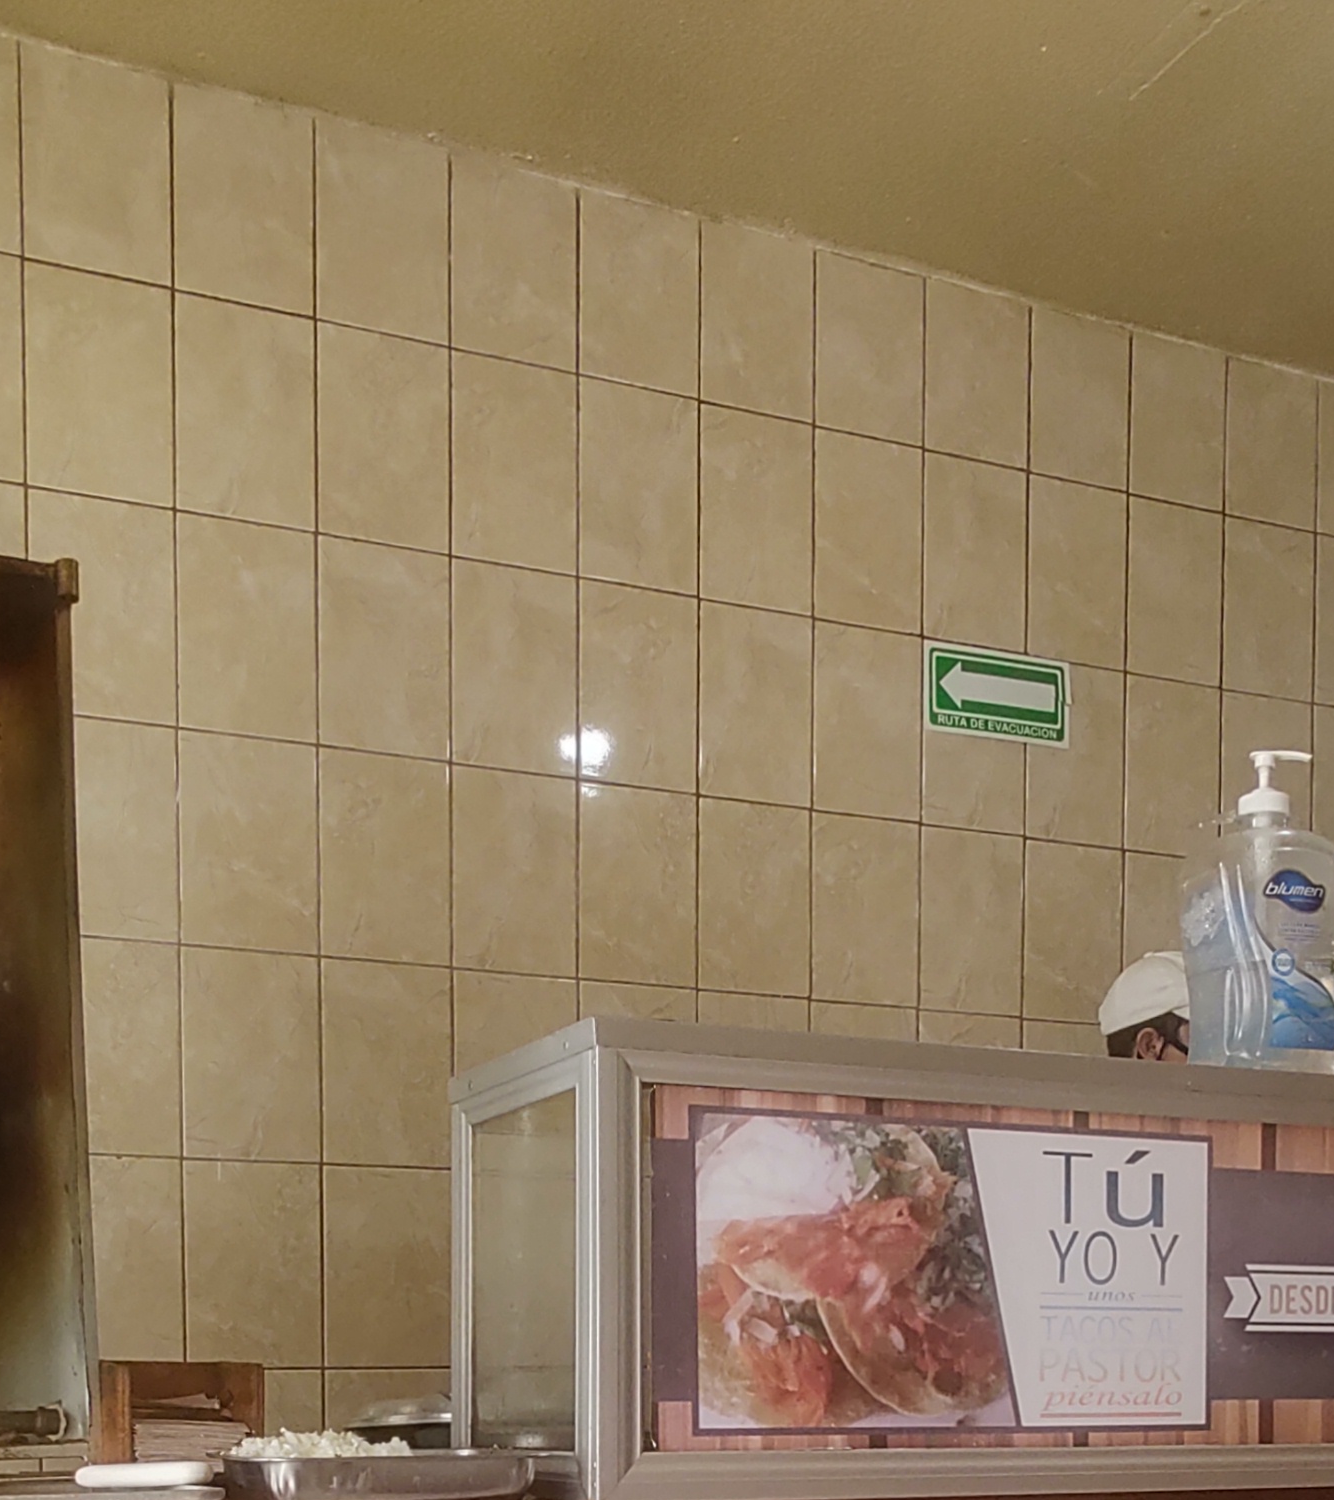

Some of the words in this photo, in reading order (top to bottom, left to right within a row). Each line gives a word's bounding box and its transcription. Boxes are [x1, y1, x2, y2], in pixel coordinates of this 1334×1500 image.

[937, 714, 967, 727] RUTA
[970, 718, 985, 729] DE
[987, 719, 1057, 739] EVACUACION
[1265, 882, 1323, 898] blumen
[1043, 1150, 1164, 1227] Tú
[1049, 1229, 1117, 1285] YO
[1150, 1233, 1180, 1286] Y
[1088, 1290, 1136, 1302] unos
[1040, 1315, 1133, 1342] TACOS
[1039, 1349, 1181, 1383] PASTOR
[1043, 1382, 1183, 1411] piénsalo
